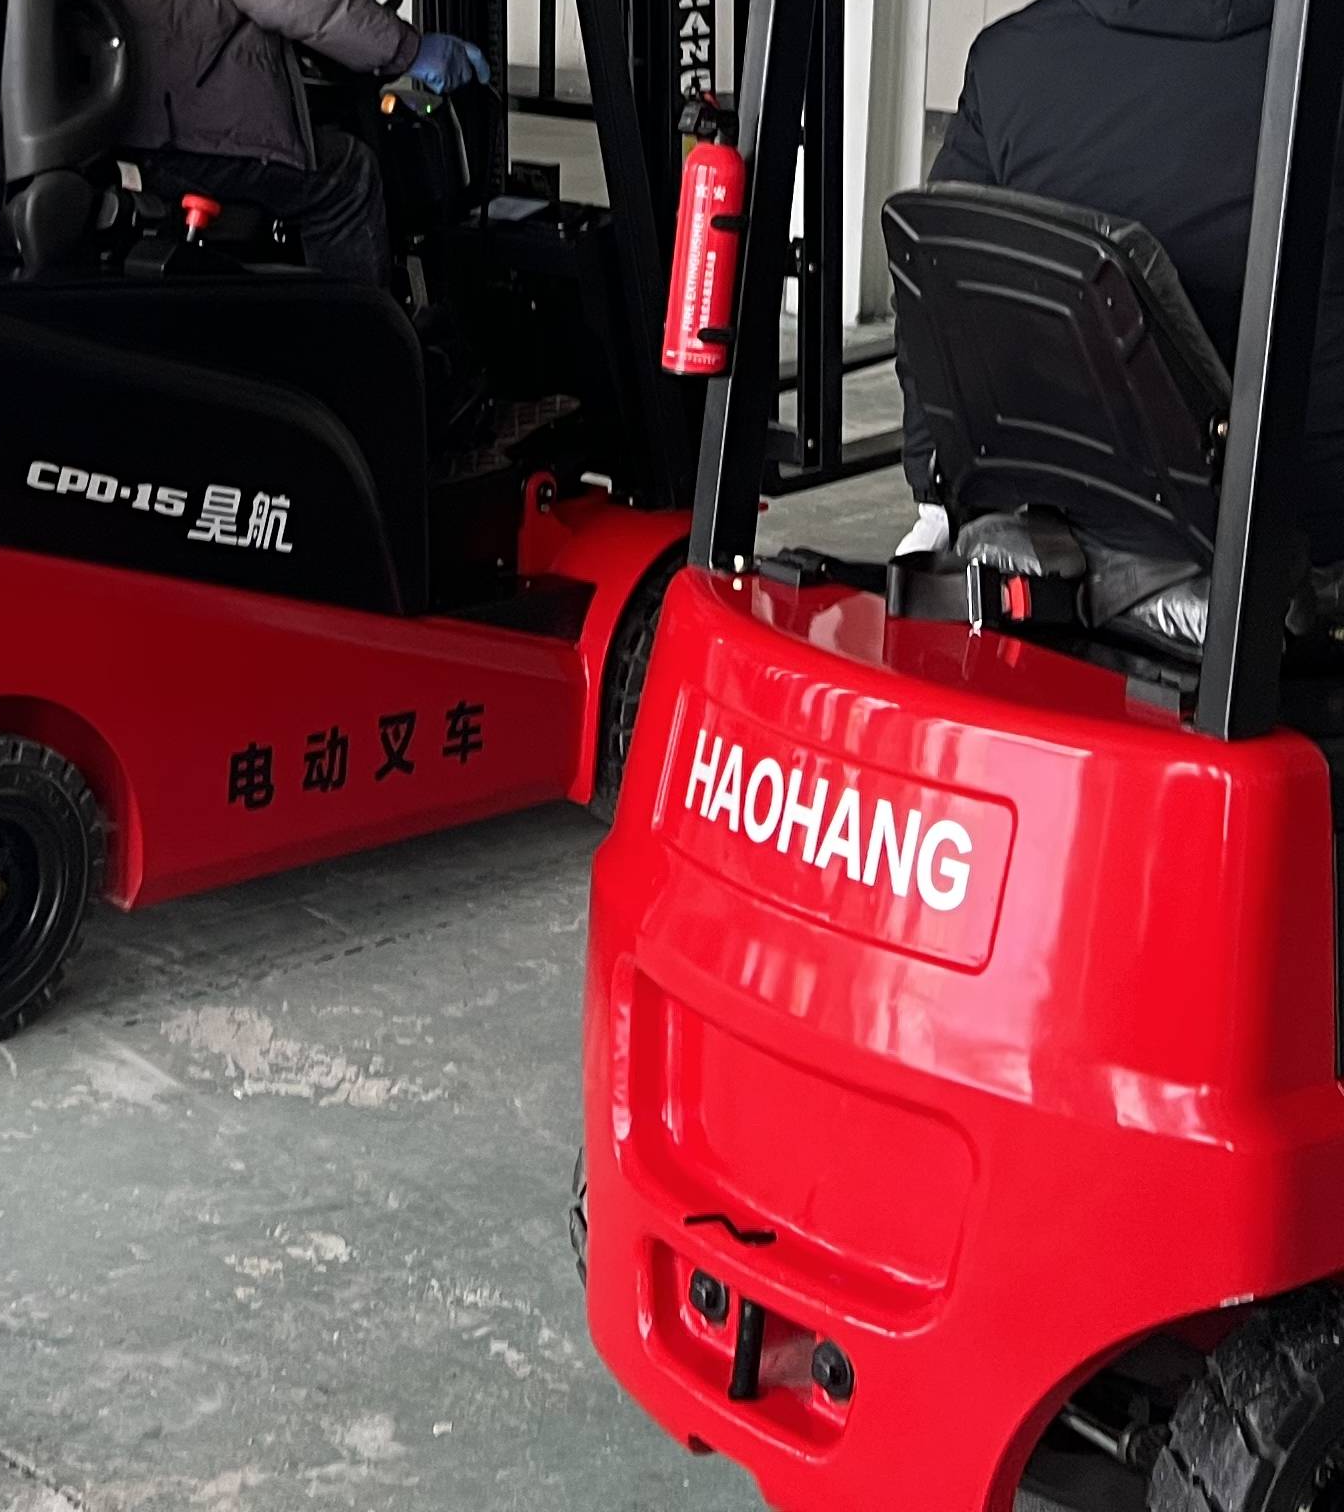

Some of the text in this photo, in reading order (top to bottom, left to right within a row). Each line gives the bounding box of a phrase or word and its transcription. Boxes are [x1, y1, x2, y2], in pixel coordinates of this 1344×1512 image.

[227, 699, 486, 810] 电动叉车
[684, 729, 973, 911] HAOHANG
